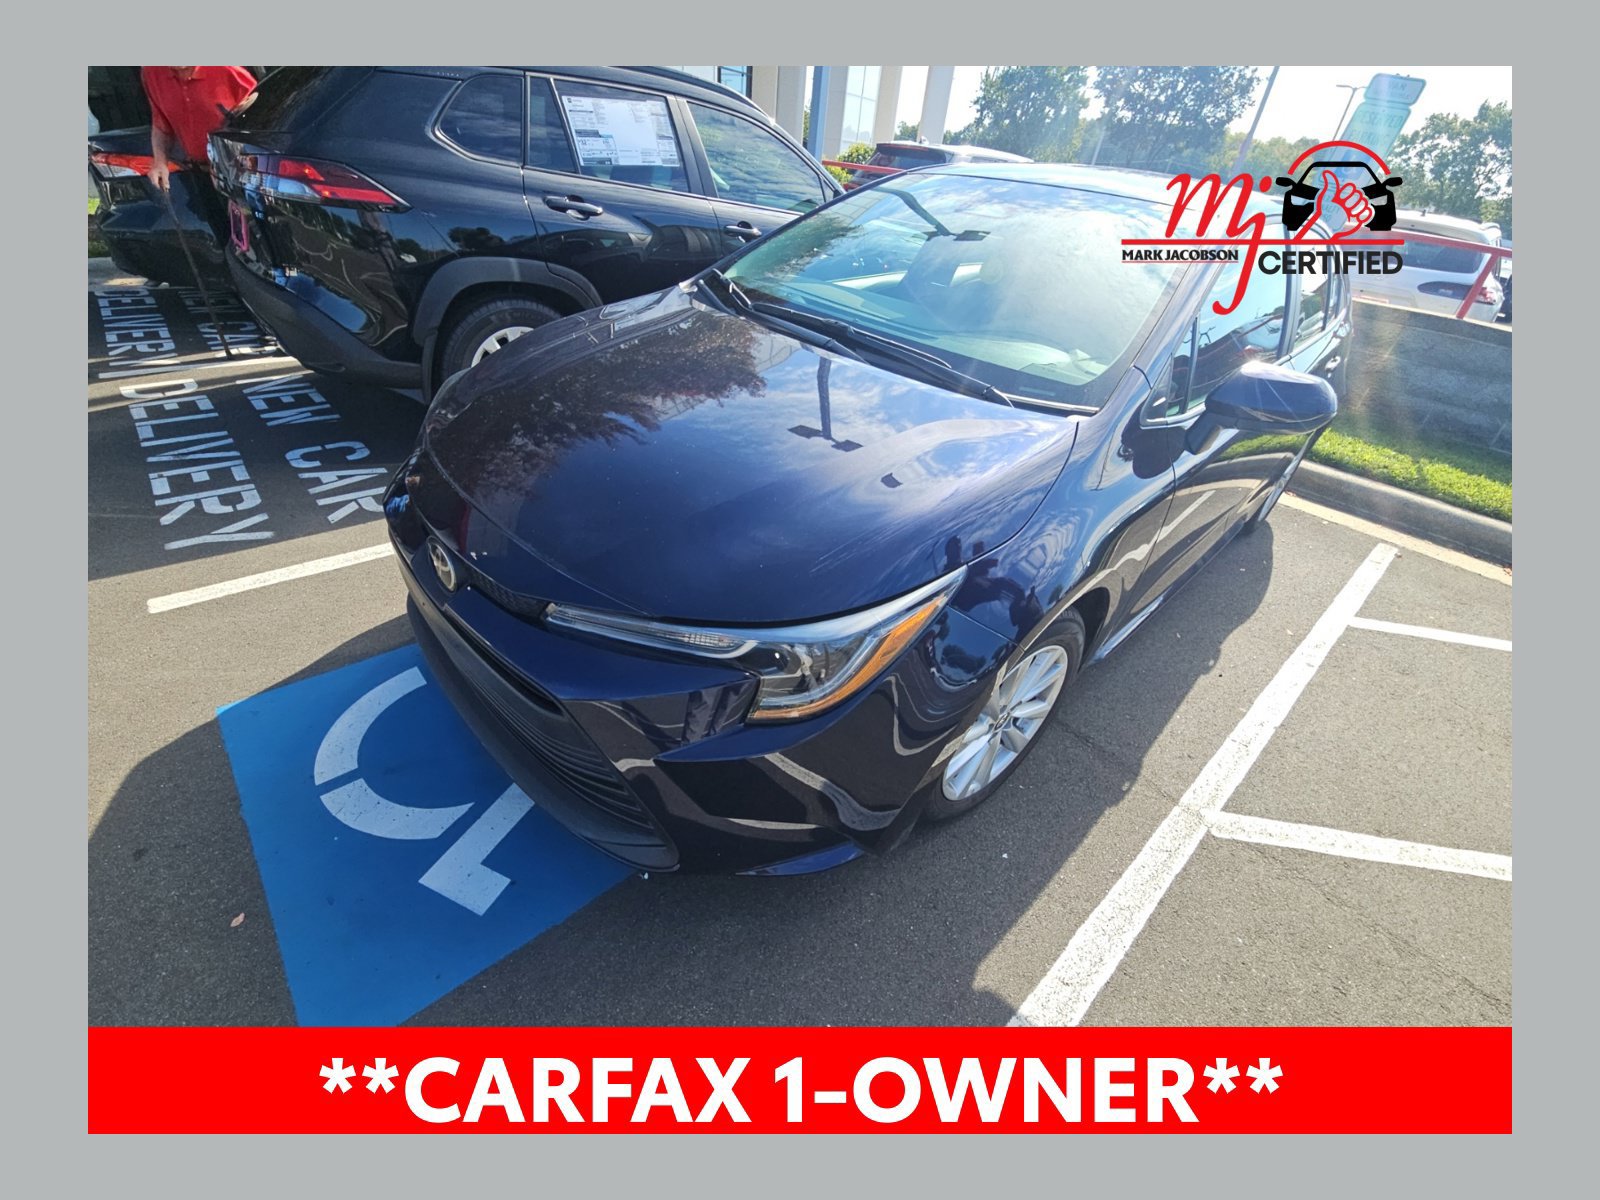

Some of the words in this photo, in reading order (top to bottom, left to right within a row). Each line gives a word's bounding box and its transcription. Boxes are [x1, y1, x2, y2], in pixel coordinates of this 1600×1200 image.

[94, 286, 182, 367] DELIVERY
[236, 374, 342, 427] NEW
[119, 378, 275, 551] DELIVERY
[284, 440, 388, 524] CAR
